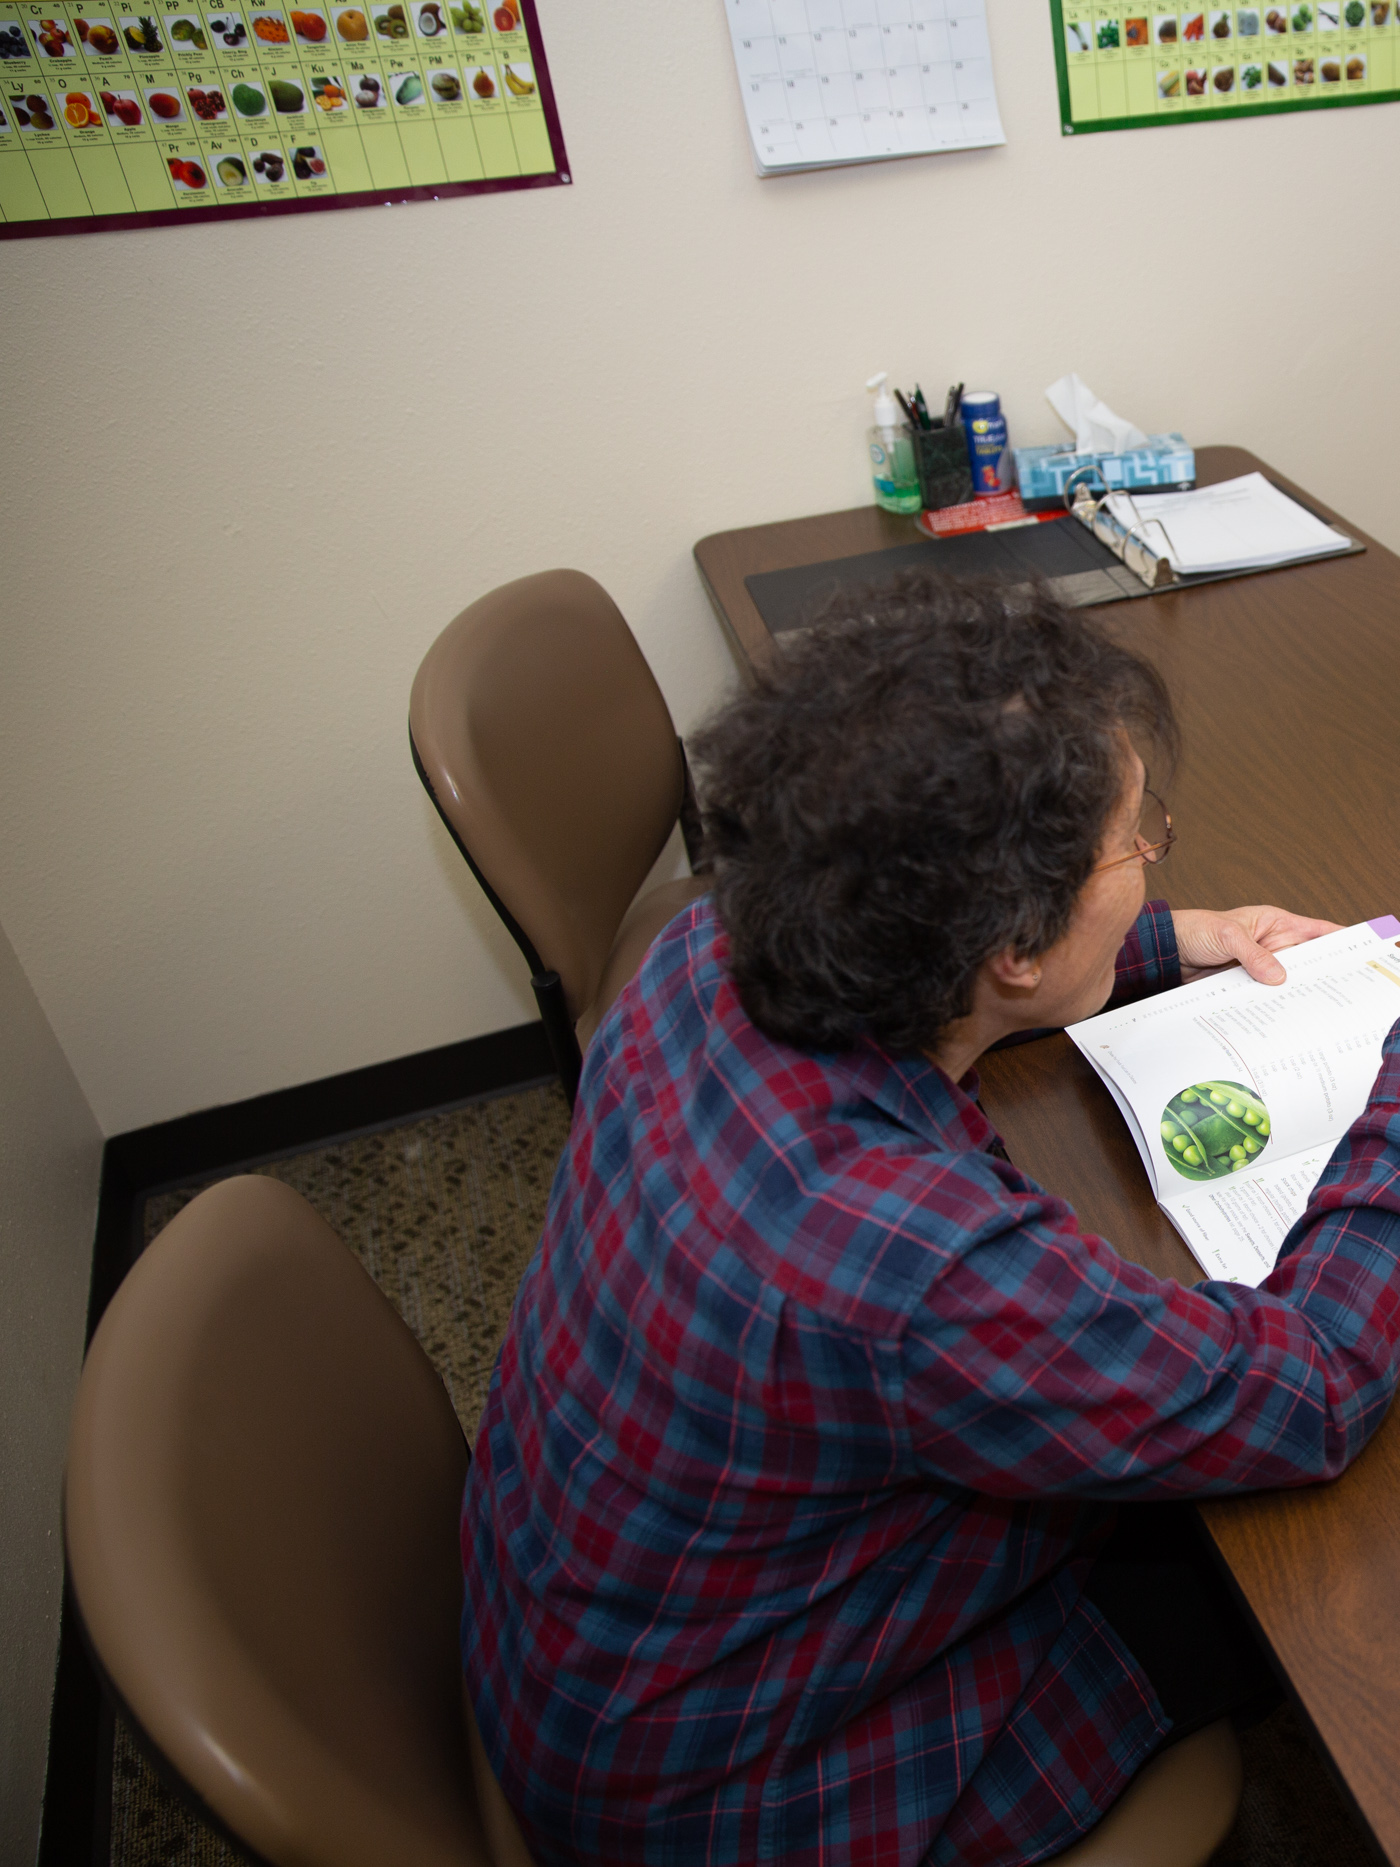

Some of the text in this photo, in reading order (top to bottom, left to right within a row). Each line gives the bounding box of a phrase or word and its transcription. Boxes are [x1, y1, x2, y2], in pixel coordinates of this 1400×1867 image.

[76, 4, 83, 13] P
[121, 2, 132, 12] Pi
[166, 1, 179, 10] PP
[210, 0, 224, 9] CB
[30, 5, 42, 15] Cr
[271, 67, 276, 76] J
[311, 64, 325, 73] Ku
[350, 62, 364, 71] Ma
[145, 74, 155, 84] M
[188, 72, 203, 83] Pg
[231, 69, 244, 79] Ch
[11, 81, 24, 92] Ly
[58, 79, 67, 88] O
[102, 77, 110, 87] A
[250, 137, 258, 147] D
[290, 134, 296, 144] F
[168, 143, 179, 153] Pr
[211, 141, 223, 150] Av
